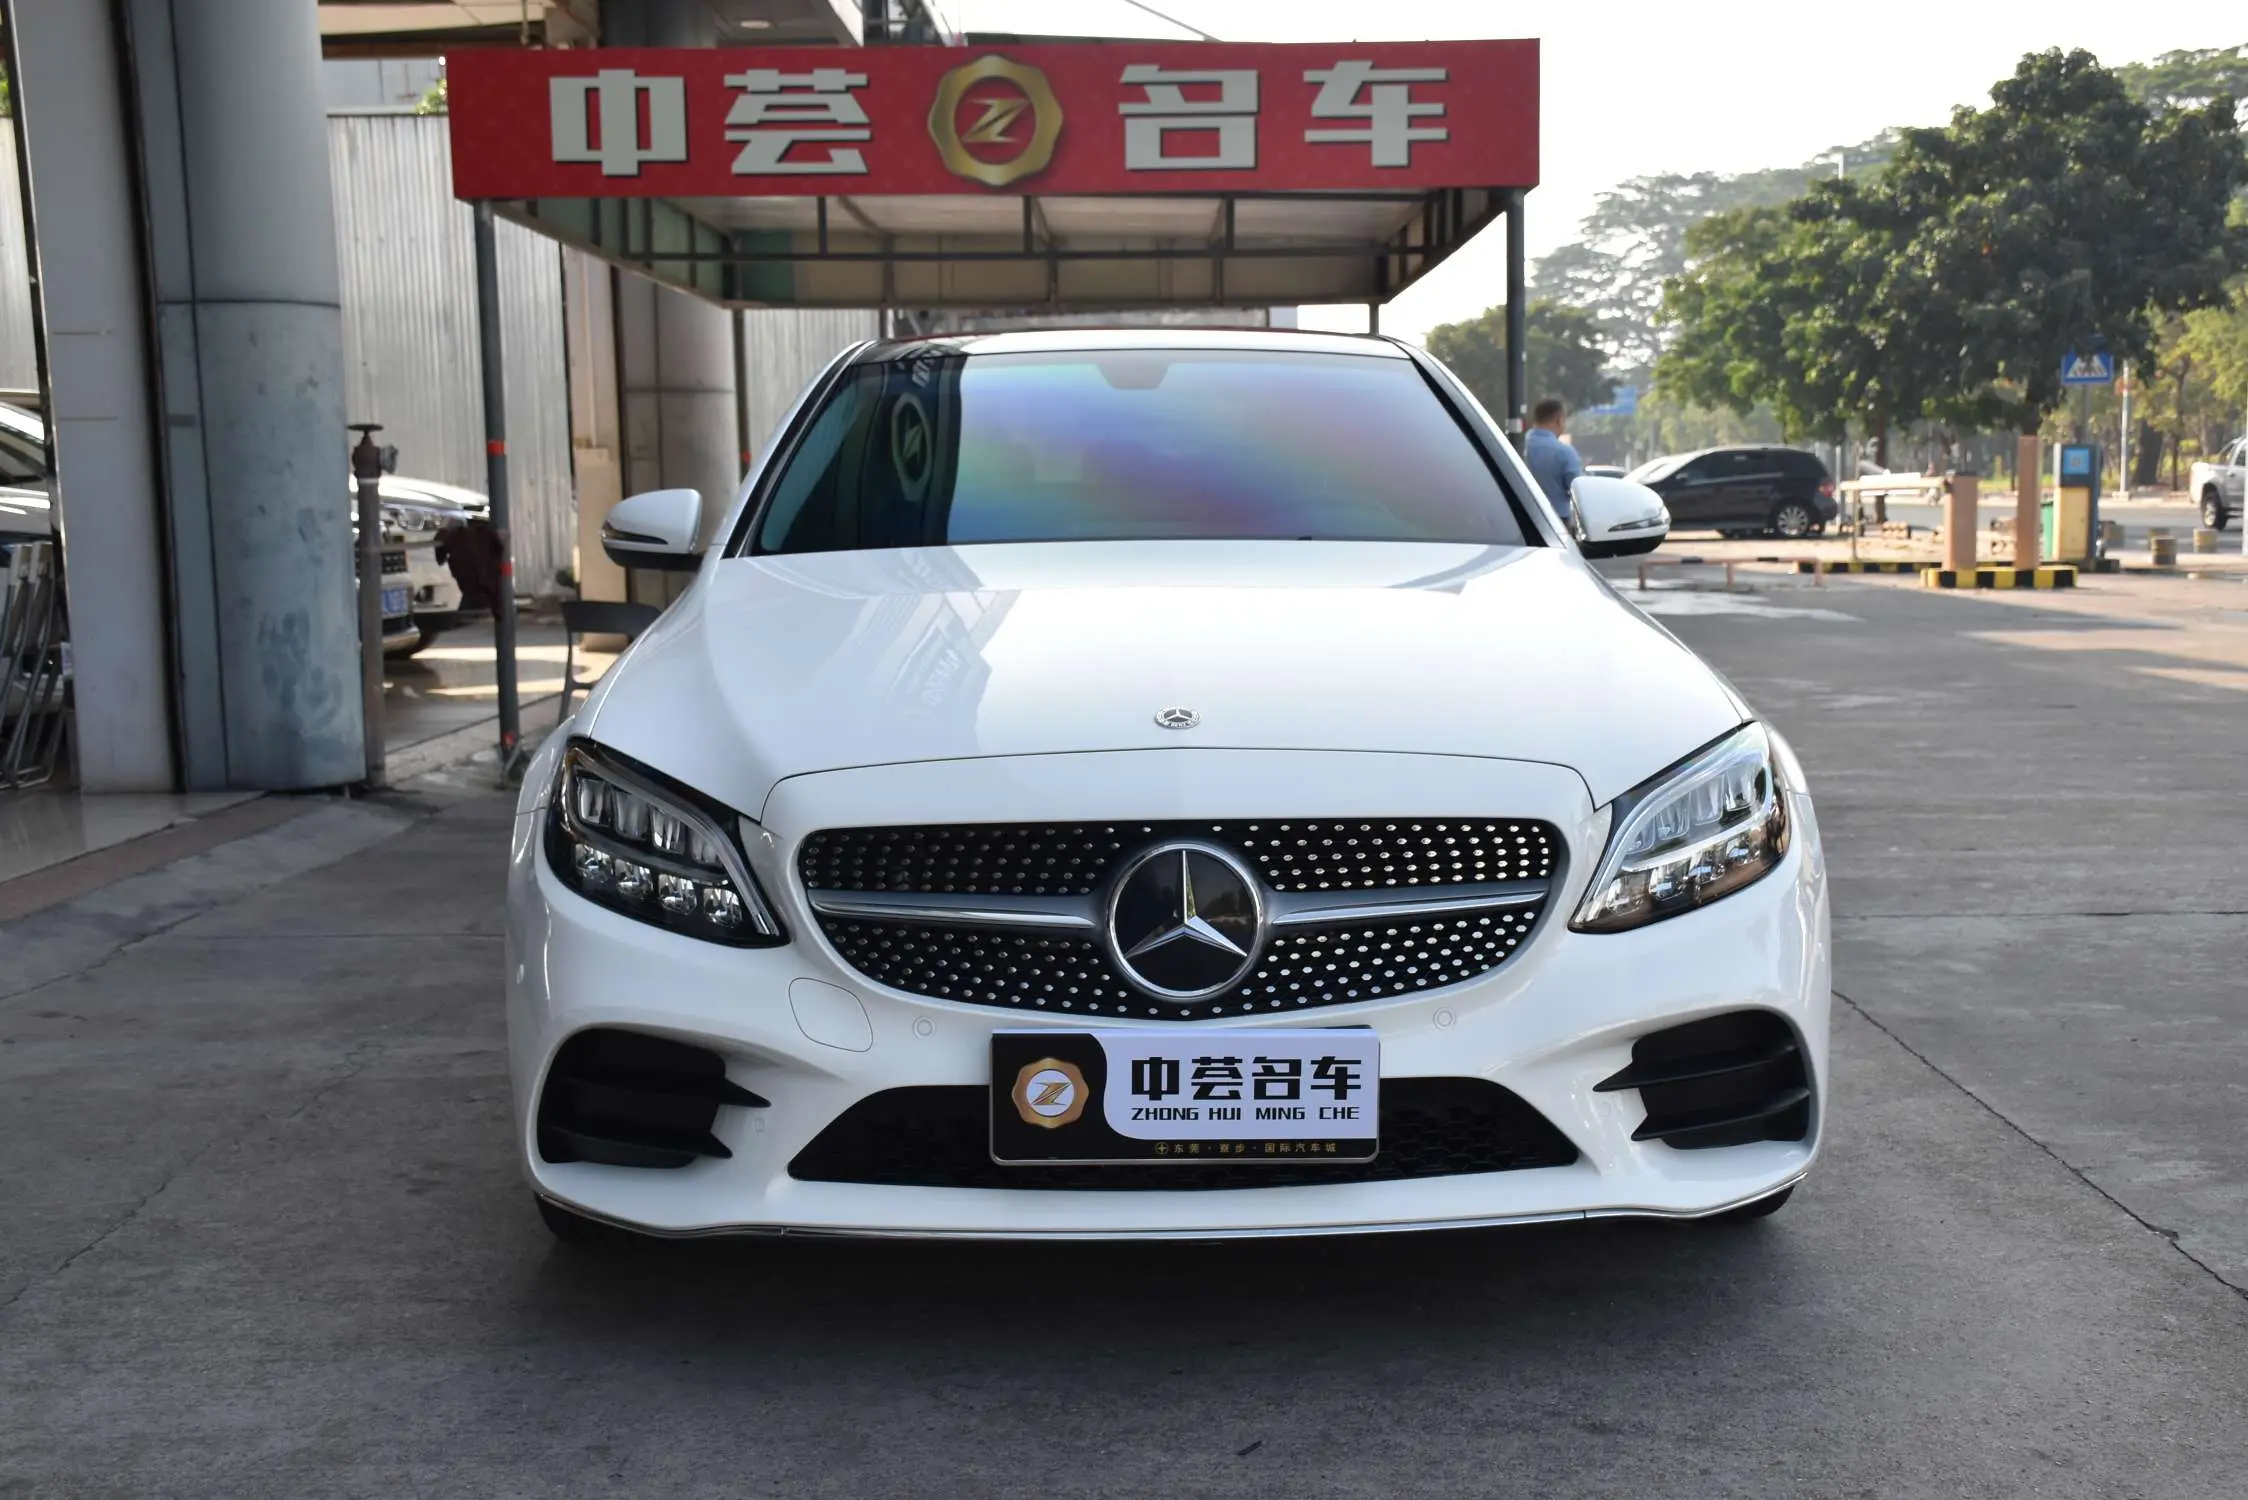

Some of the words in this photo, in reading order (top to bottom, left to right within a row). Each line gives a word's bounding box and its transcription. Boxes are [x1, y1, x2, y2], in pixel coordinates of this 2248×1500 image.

[549, 68, 871, 176] 中荟
[1118, 60, 1448, 171] 名车
[1131, 1056, 1362, 1101] 中荟名车
[1131, 1107, 1199, 1121] ZHONG
[1208, 1107, 1241, 1121] HUI
[1255, 1107, 1305, 1121] MING
[1319, 1106, 1360, 1120] CHE
